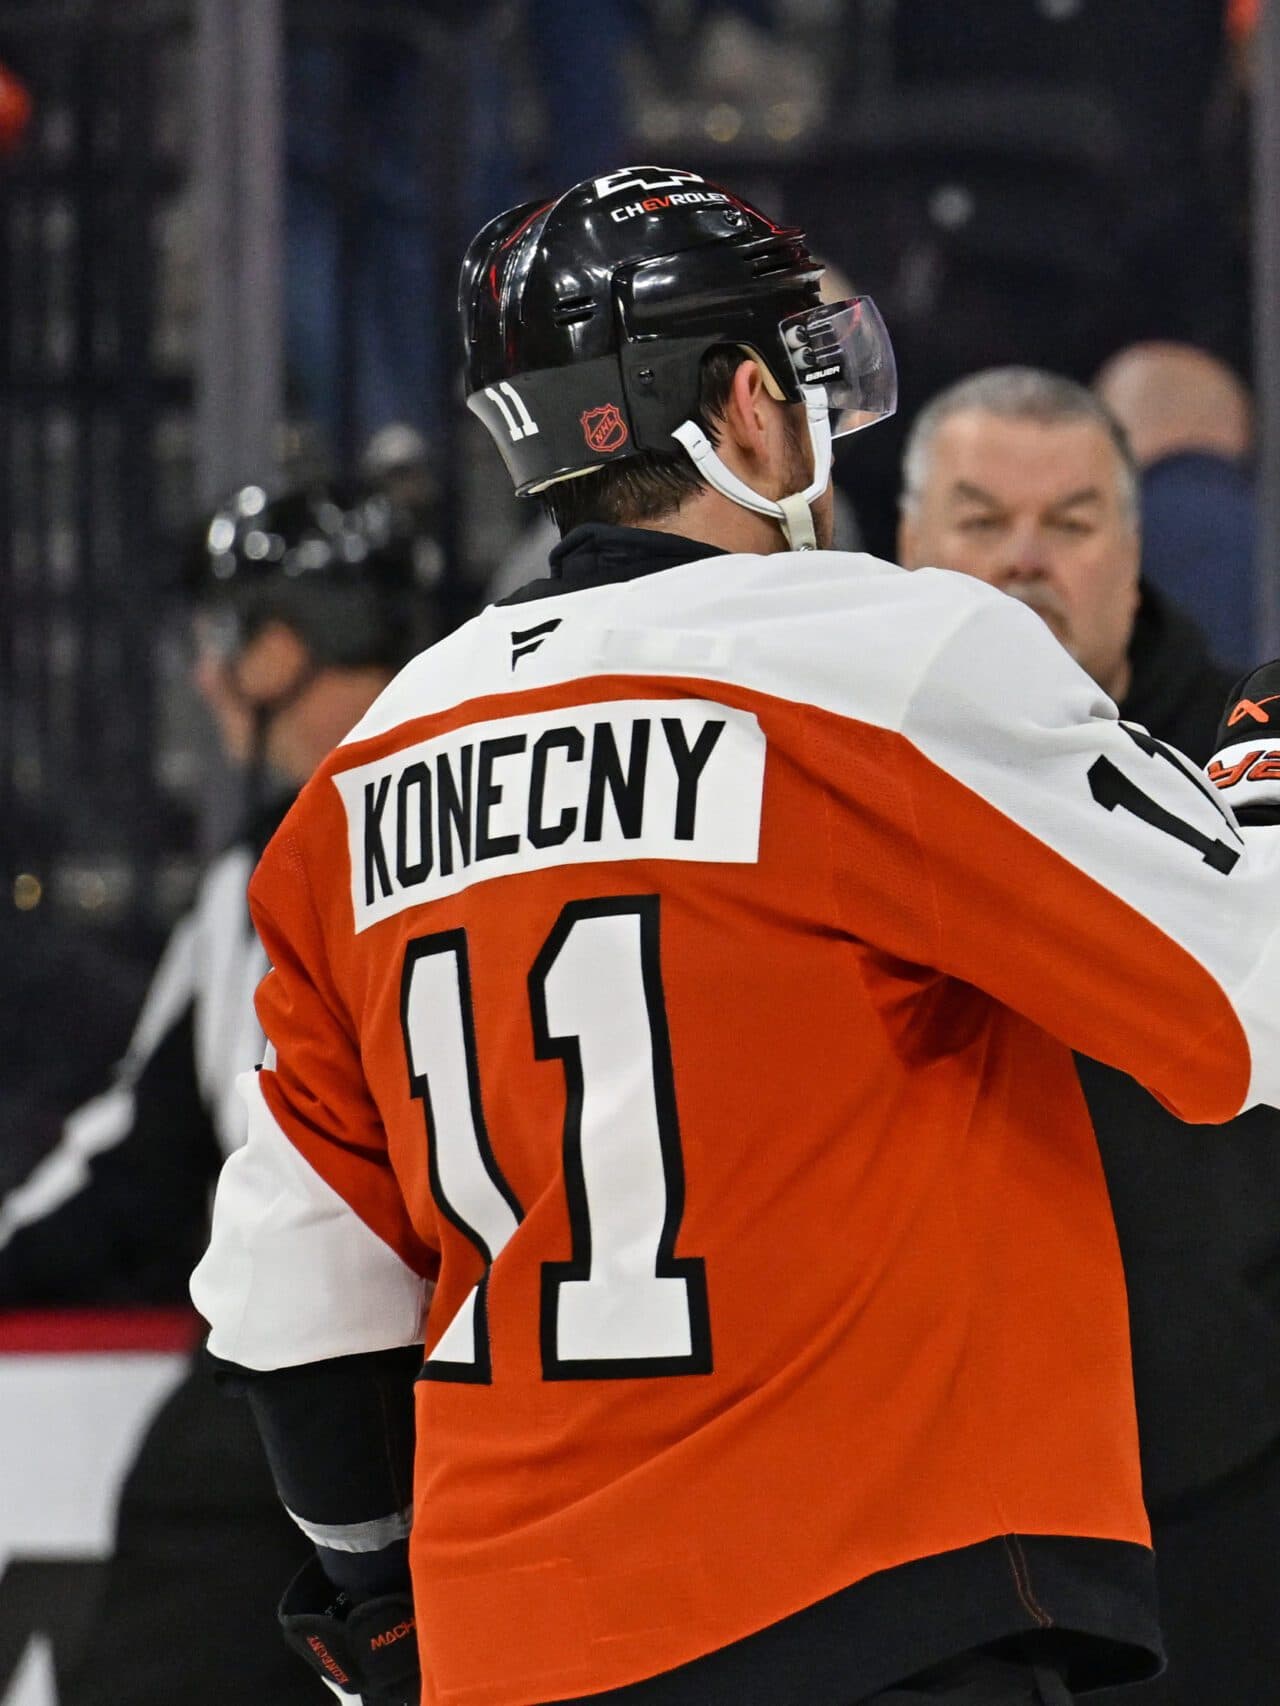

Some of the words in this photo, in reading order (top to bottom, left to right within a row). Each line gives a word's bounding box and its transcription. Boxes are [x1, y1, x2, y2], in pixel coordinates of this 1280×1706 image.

[610, 192, 730, 223] CHEVROLET
[805, 365, 841, 382] BAUER
[485, 381, 540, 442] 11
[363, 717, 727, 908] KONECNY
[400, 893, 713, 1385] 11
